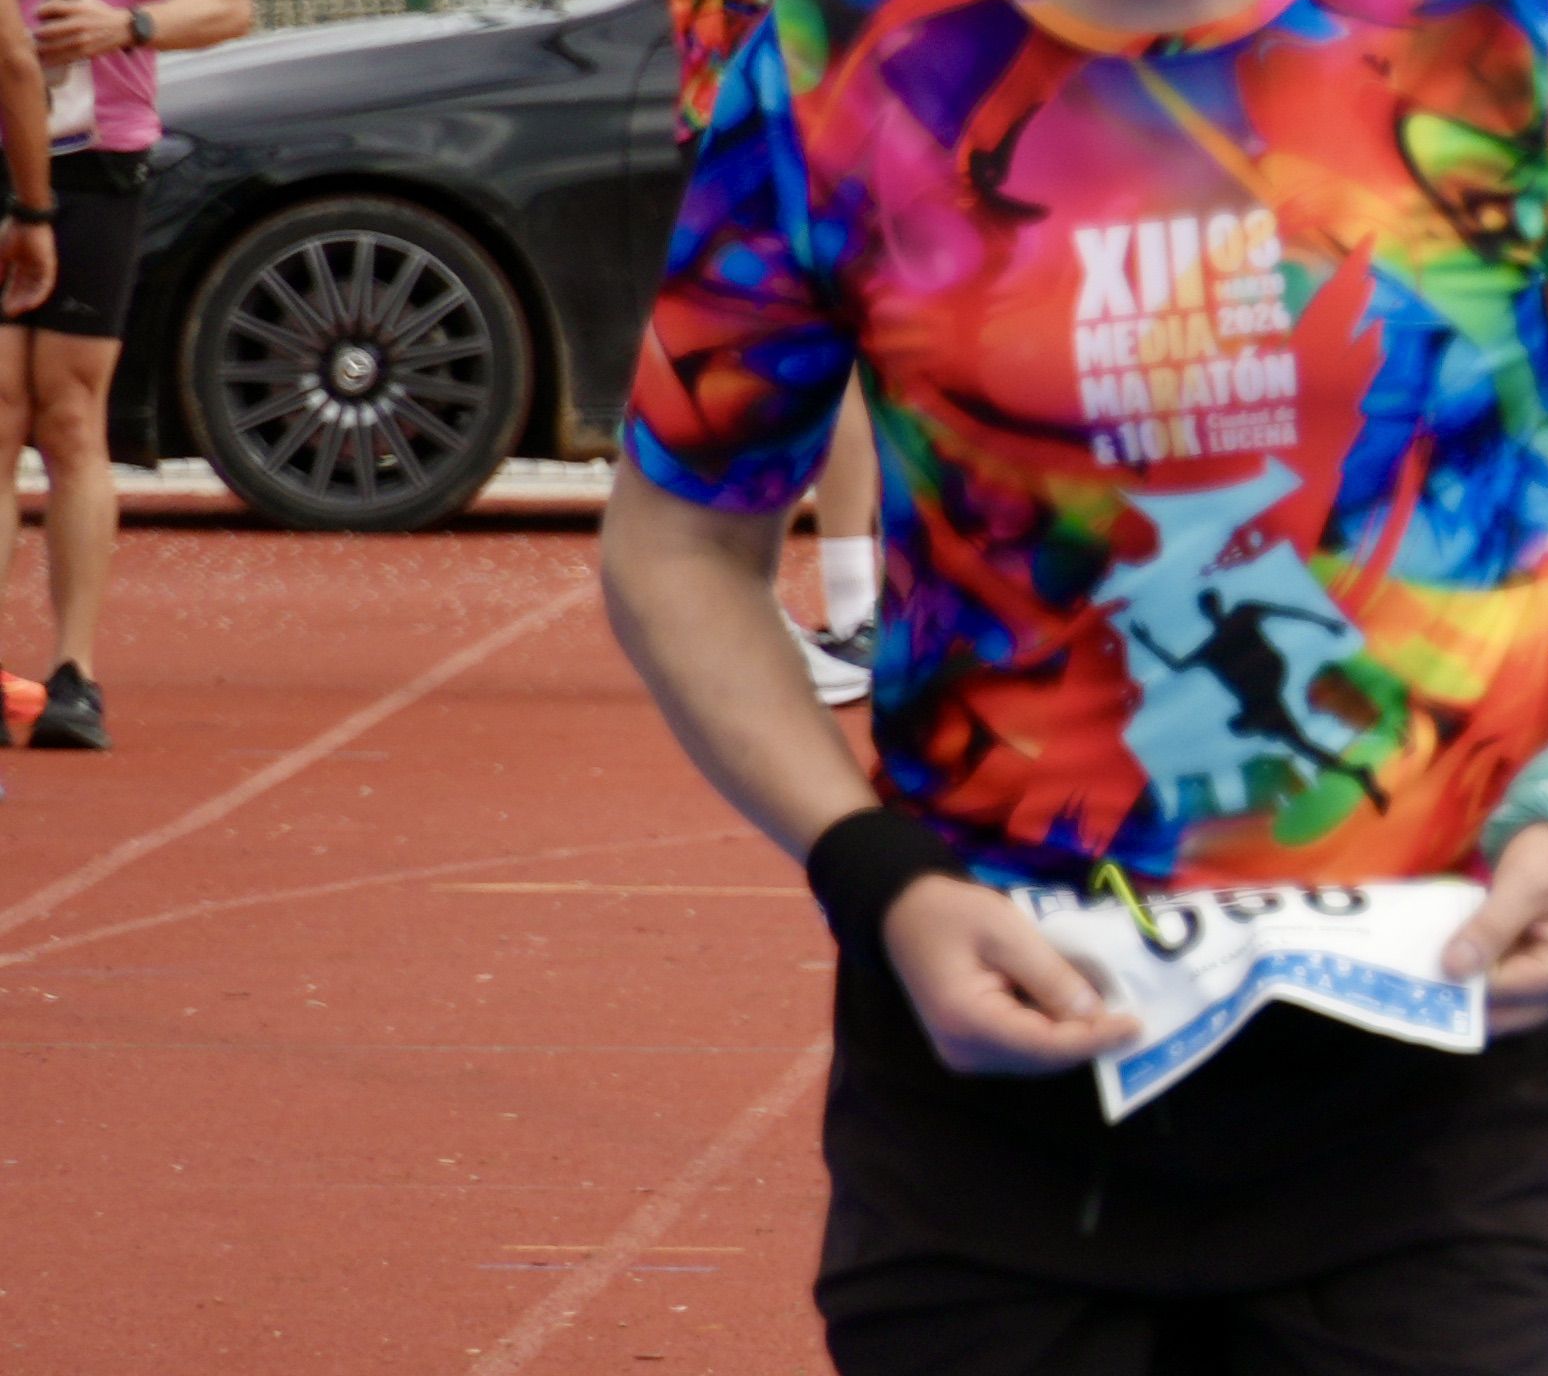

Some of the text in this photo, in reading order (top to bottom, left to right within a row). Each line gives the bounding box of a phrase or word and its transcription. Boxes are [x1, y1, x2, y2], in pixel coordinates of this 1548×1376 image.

[1074, 208, 1284, 321] XII 08
[1074, 311, 1219, 373] MEDIA
[1080, 344, 1298, 420] MARATÓN
[1119, 414, 1203, 463] 10K
